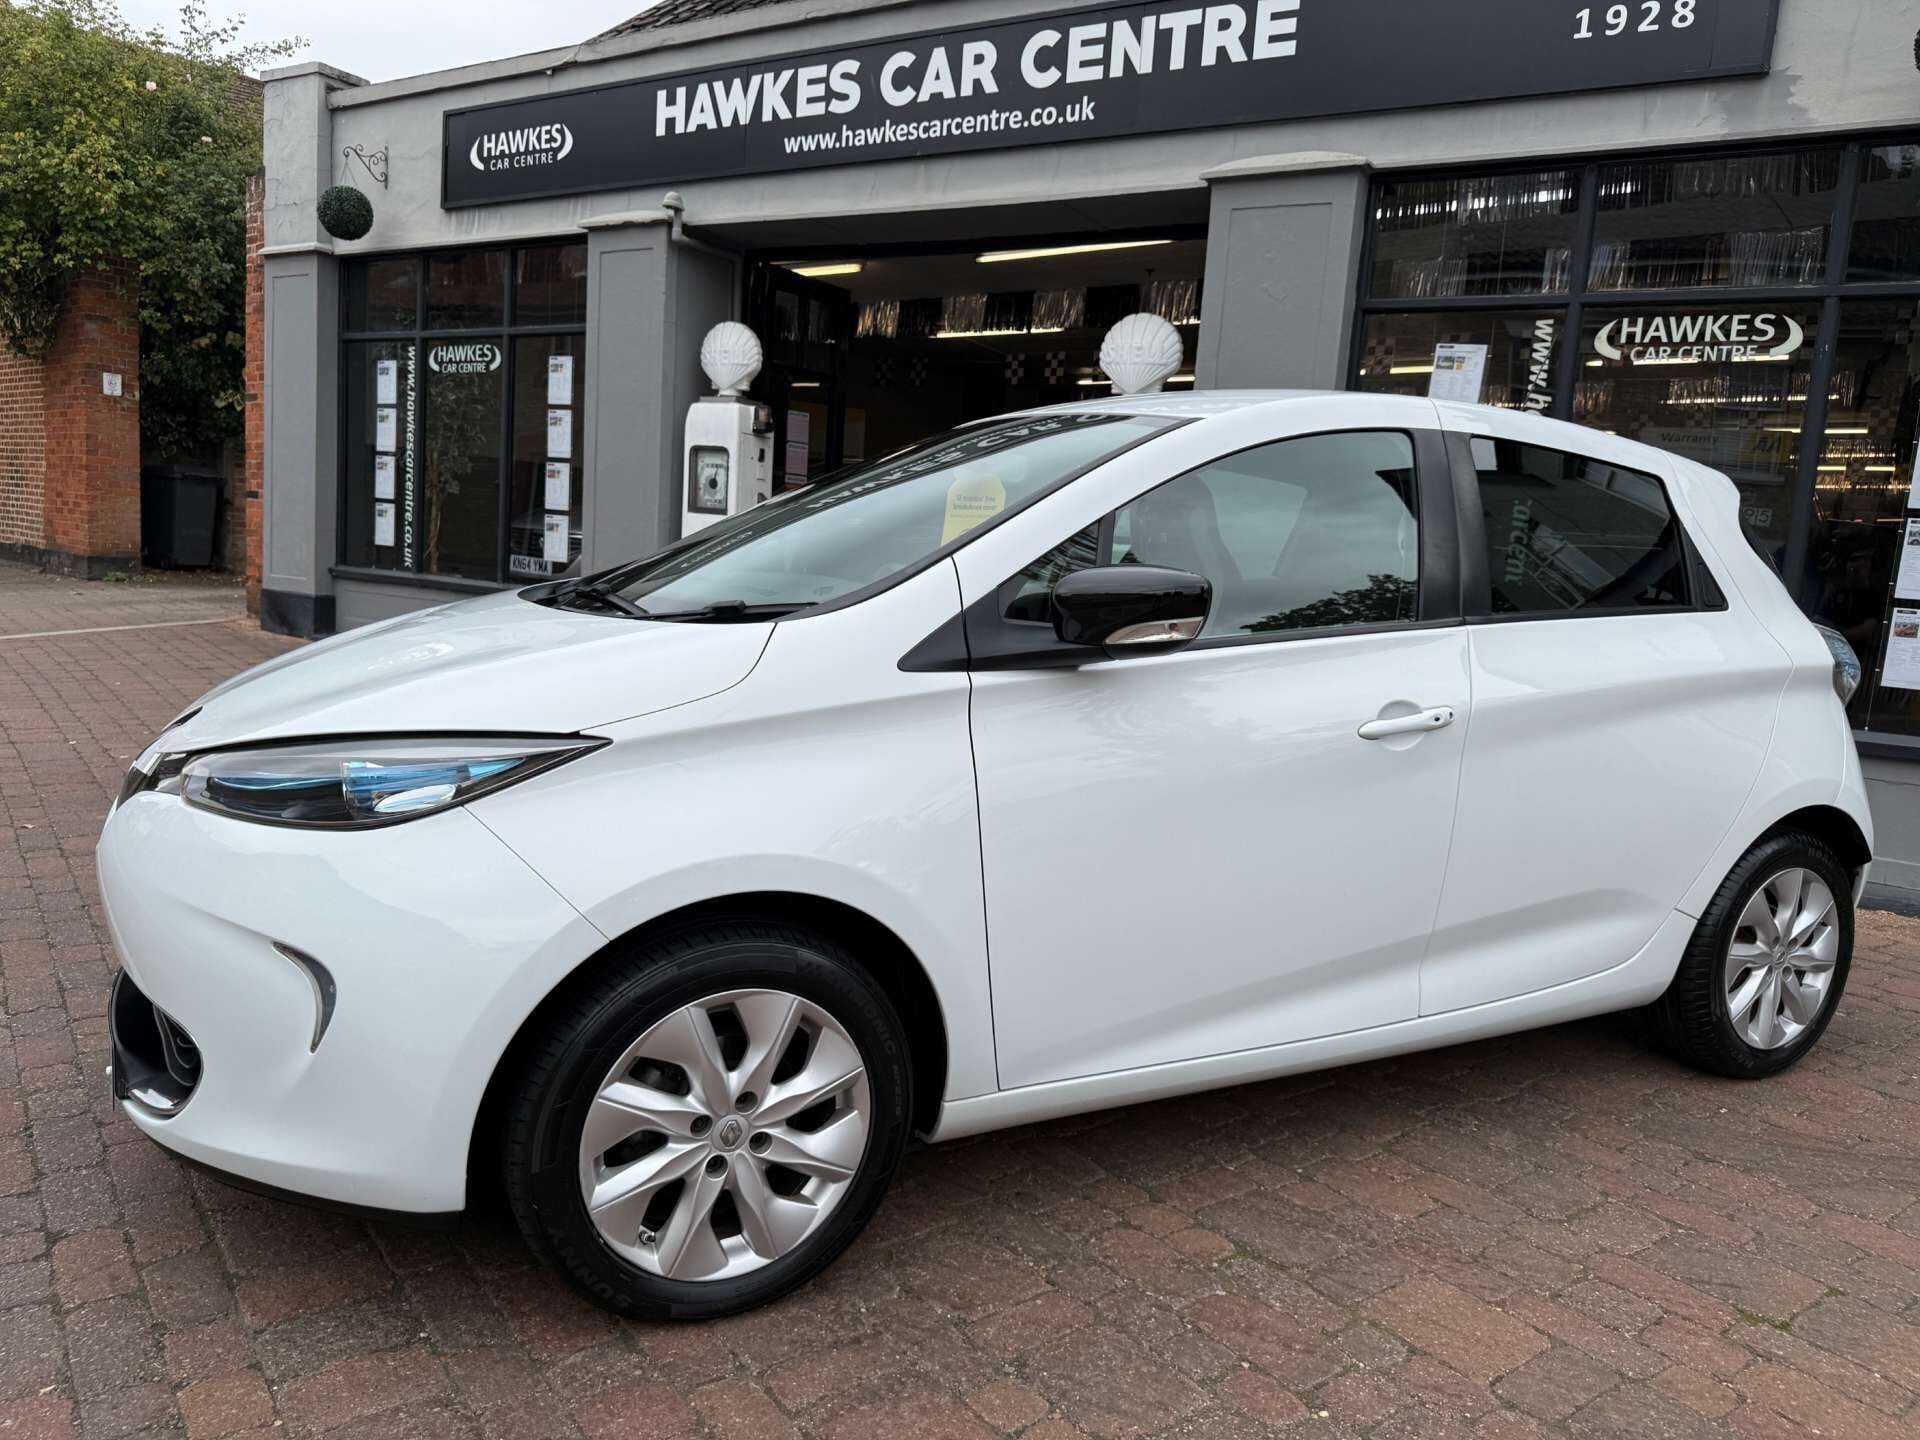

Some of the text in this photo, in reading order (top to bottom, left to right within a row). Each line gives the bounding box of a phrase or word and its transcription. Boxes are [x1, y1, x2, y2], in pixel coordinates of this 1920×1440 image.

[1573, 0, 1697, 39] 1928
[655, 0, 1300, 137] HAWKES CAR CENTRE
[783, 95, 1096, 154] www.hawkescarcentre.co.uk
[483, 123, 562, 157] HAWKES
[490, 152, 554, 171] CAR CENTRE
[1620, 313, 1776, 344] HAWKES
[437, 344, 492, 363] HAWKES
[1102, 343, 1169, 363] SHELL
[1629, 344, 1758, 363] CAR CENTRE
[441, 362, 487, 374] CAR CENTRE
[1660, 432, 1720, 447] Warranty
[404, 346, 416, 568] www.hawkescarcentre.co.uk
